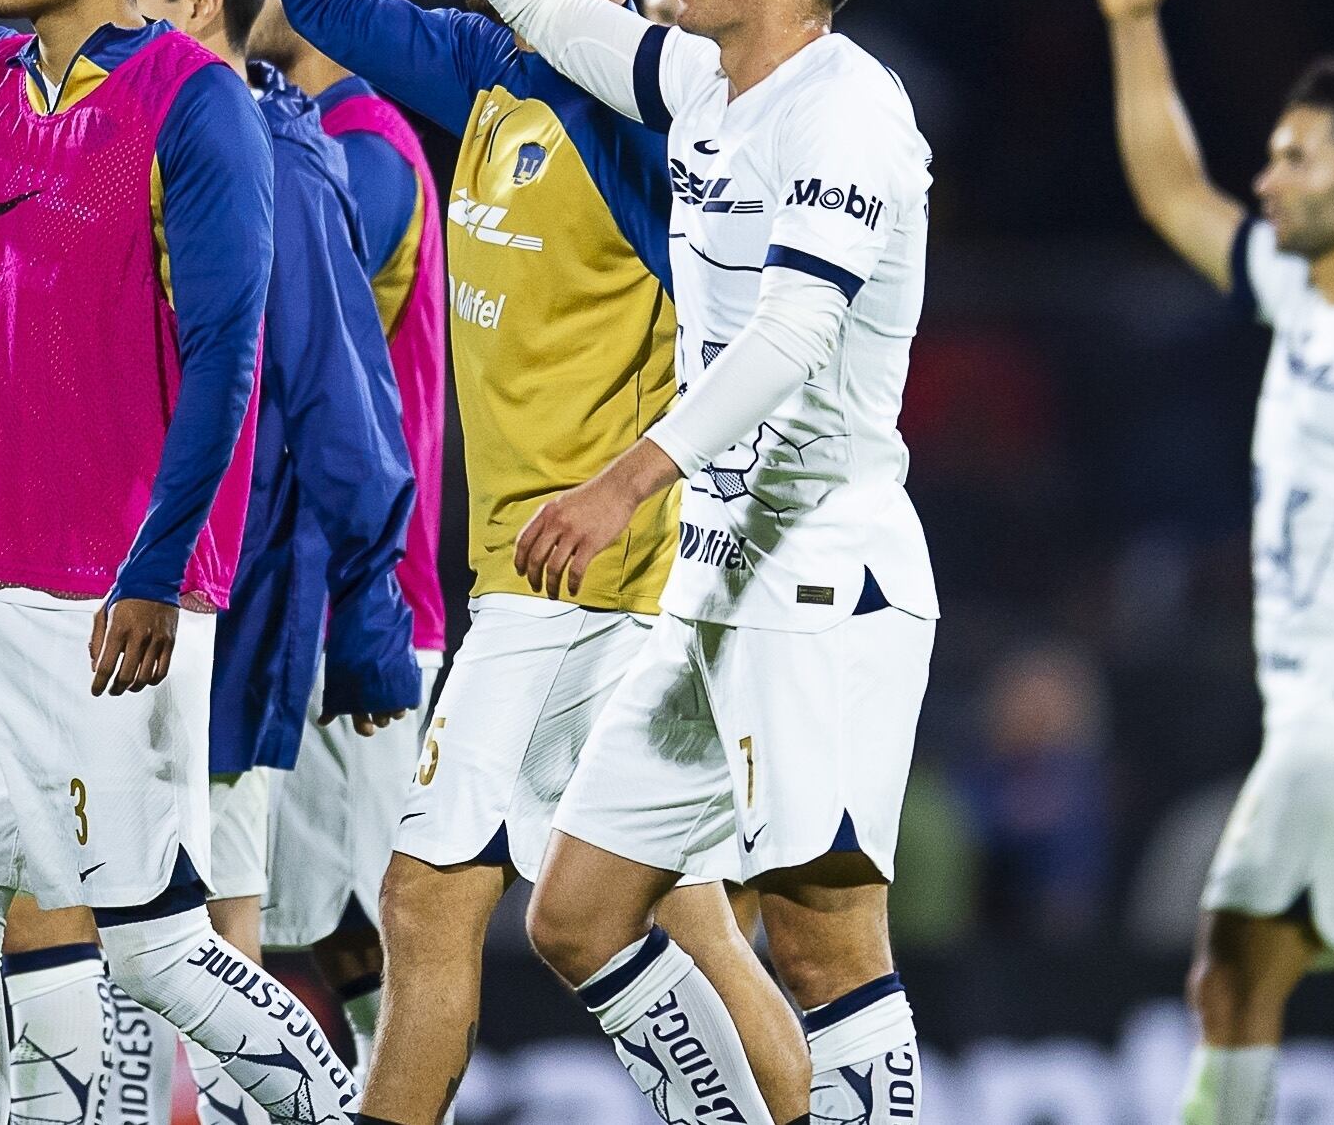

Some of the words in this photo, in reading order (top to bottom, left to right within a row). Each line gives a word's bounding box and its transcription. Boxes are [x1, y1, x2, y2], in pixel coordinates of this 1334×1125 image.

[785, 177, 883, 231] Mobil
[457, 281, 506, 330] Mifel
[70, 778, 88, 846] 3
